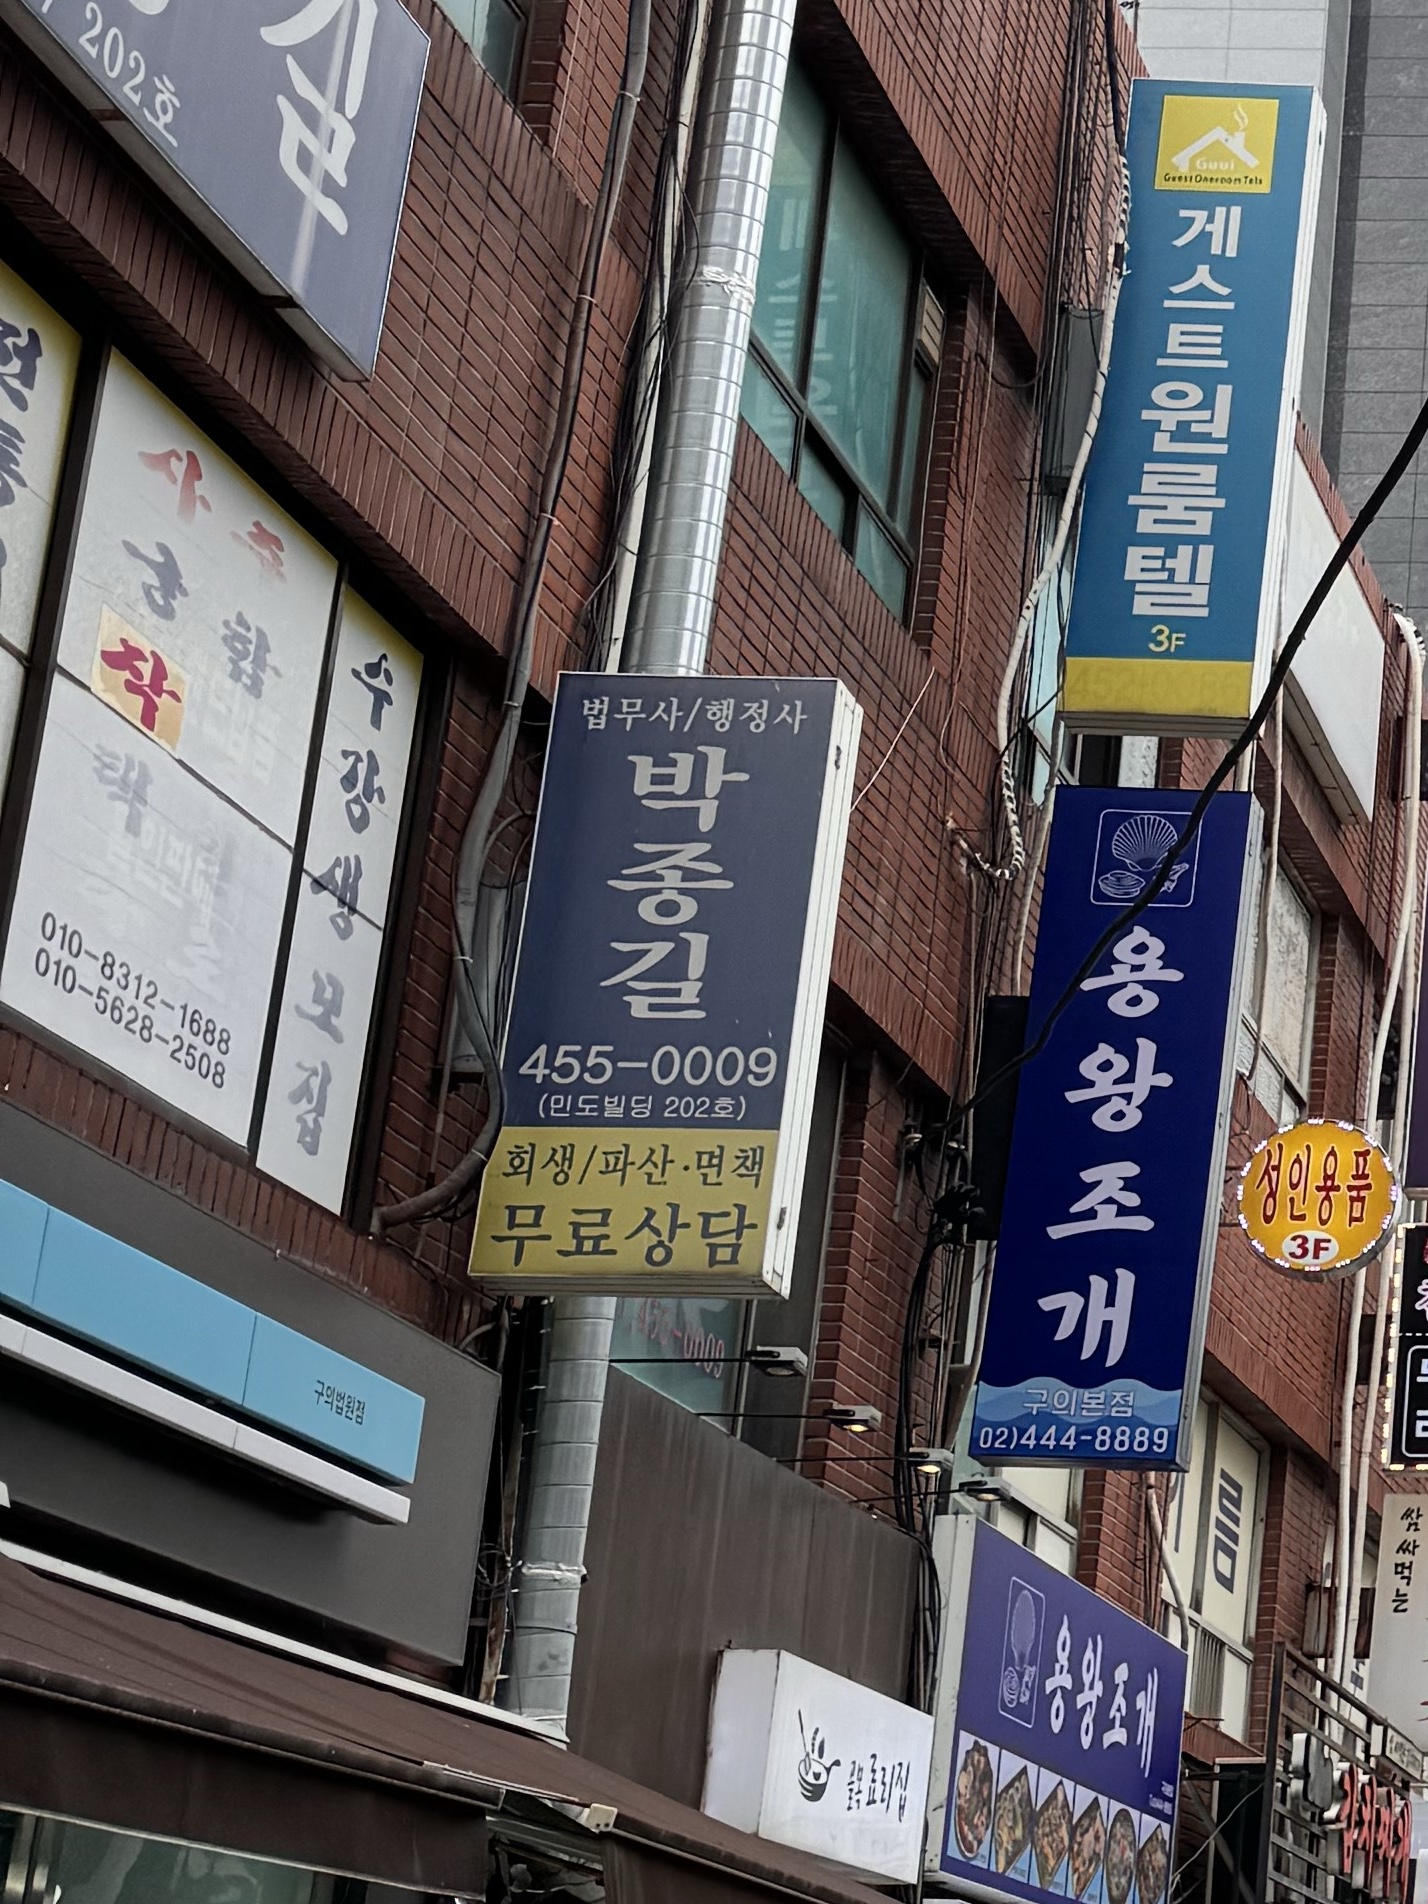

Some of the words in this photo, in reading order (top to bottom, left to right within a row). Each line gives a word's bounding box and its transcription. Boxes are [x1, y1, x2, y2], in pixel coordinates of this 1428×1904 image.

[78, 0, 181, 148] 202호
[1125, 204, 1243, 619] 게스트원룸텔
[1148, 625, 1187, 654] 3F
[582, 696, 808, 734] 법무사/행정사
[311, 651, 398, 942] 수강생
[599, 744, 751, 1020] 박종길
[40, 911, 232, 1056] 010-8312-1688
[34, 947, 227, 1089] 010-5628-2508
[518, 1043, 778, 1087] 455-0009
[537, 1093, 654, 1120] (민도빌딩
[663, 1093, 747, 1121] 202호)
[1036, 924, 1184, 1368] 용왕조개
[1254, 1143, 1374, 1227] 성인용품
[490, 1202, 759, 1270] 무료상담
[1286, 1233, 1332, 1261] 3F
[314, 1378, 367, 1427] 구의법원점
[978, 1417, 1170, 1456] 02)444-8889
[1022, 1388, 1135, 1419] 구의본점
[1399, 1506, 1424, 1534] 쌈
[1045, 1614, 1159, 1778] 용왕조개
